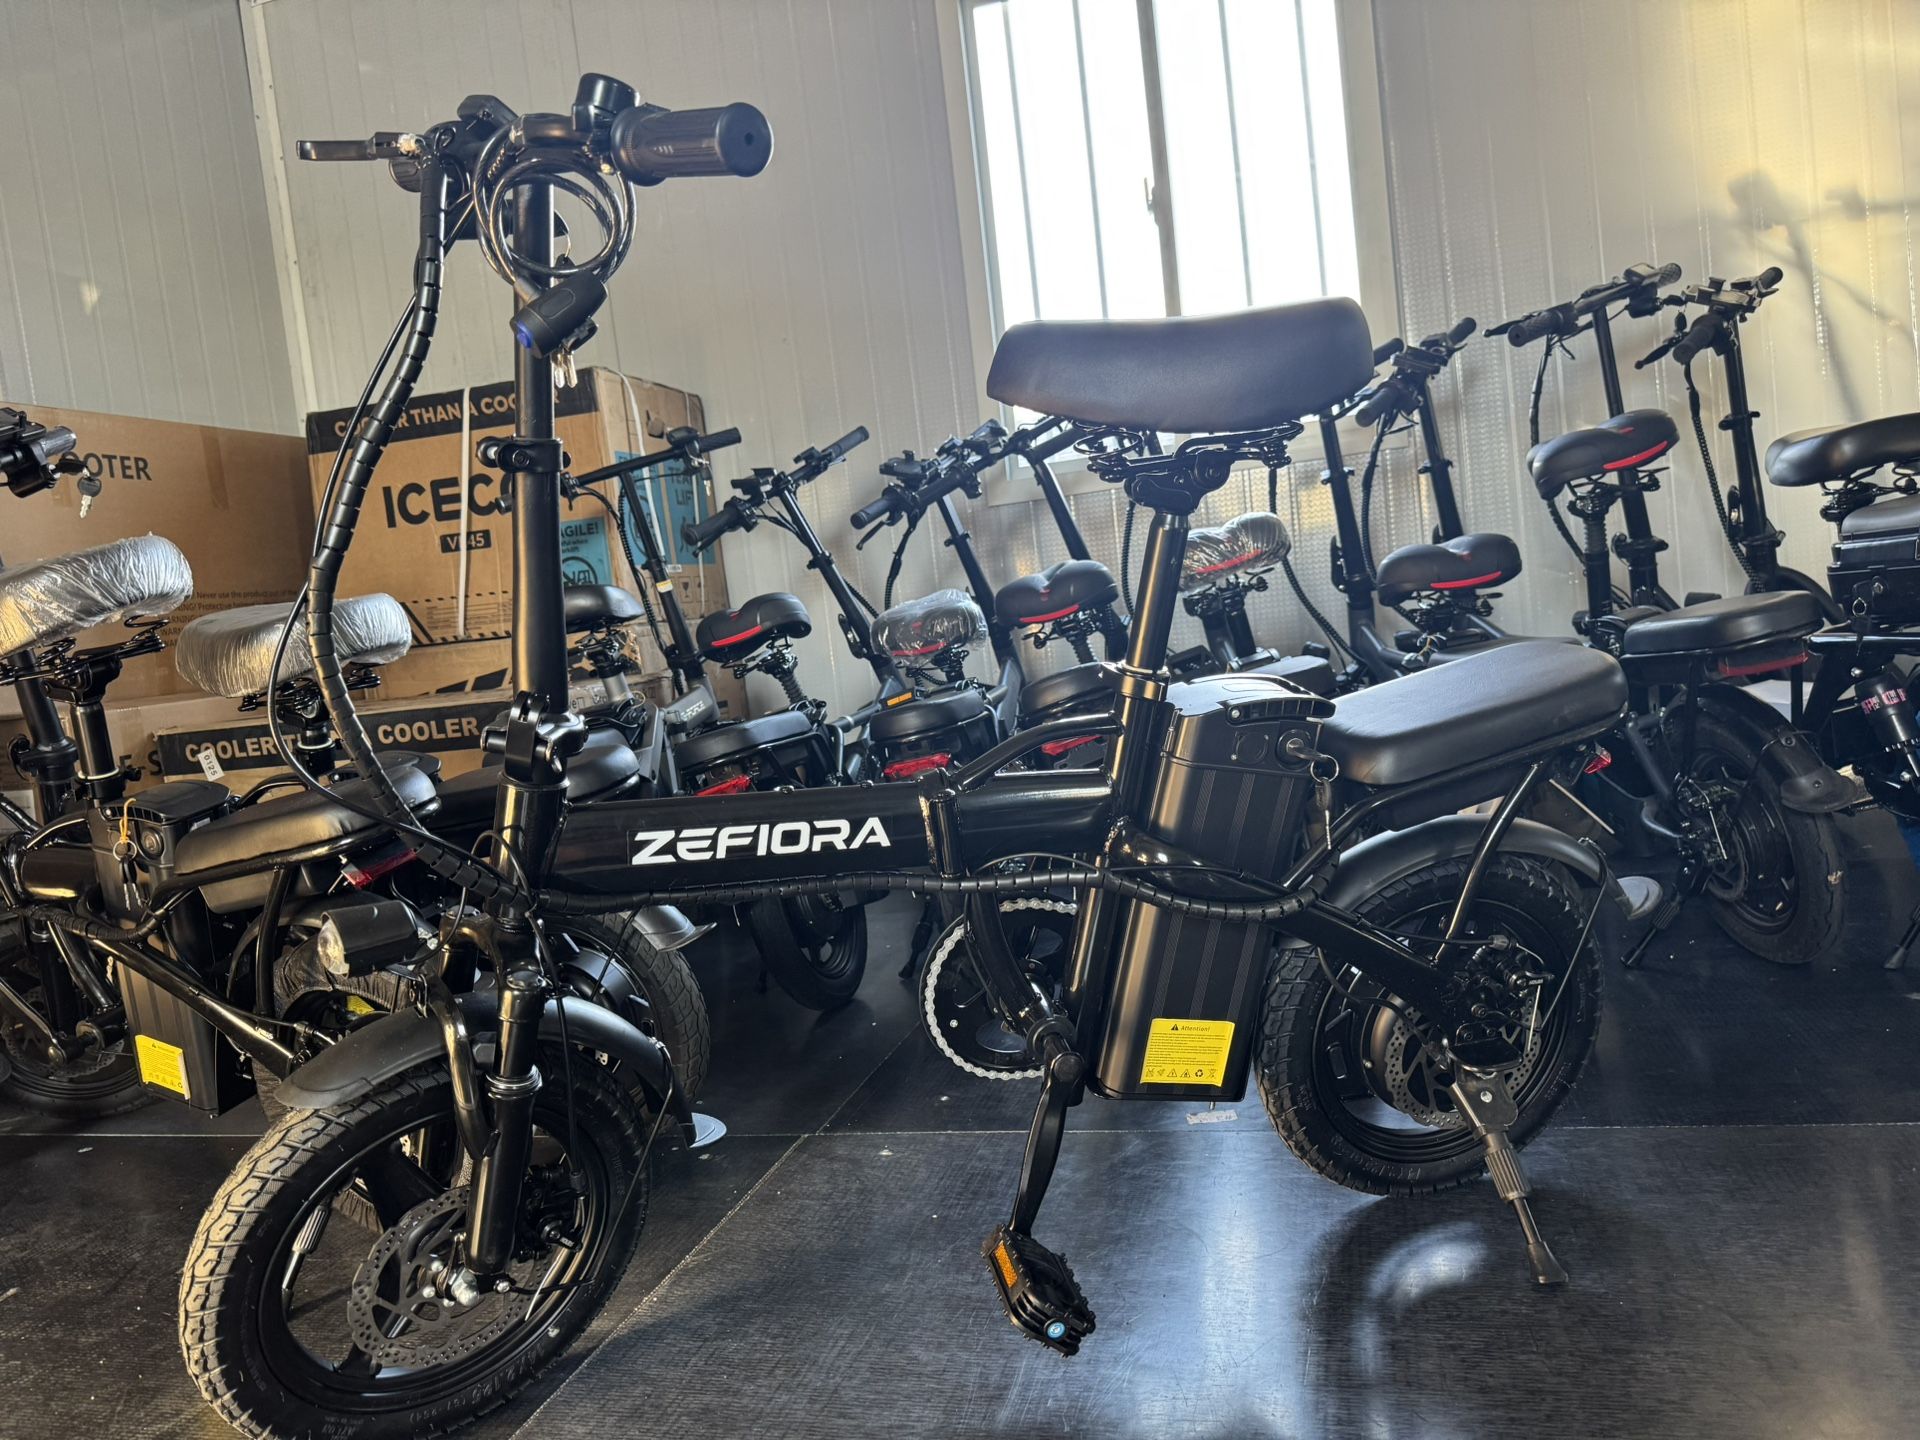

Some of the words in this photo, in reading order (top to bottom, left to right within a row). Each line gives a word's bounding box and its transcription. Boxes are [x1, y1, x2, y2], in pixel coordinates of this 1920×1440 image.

[409, 403, 461, 426] THAN
[446, 532, 485, 550] V45
[378, 717, 480, 744] COOLER
[632, 816, 891, 866] ZEFIORA
[1180, 1024, 1210, 1032] Attention!
